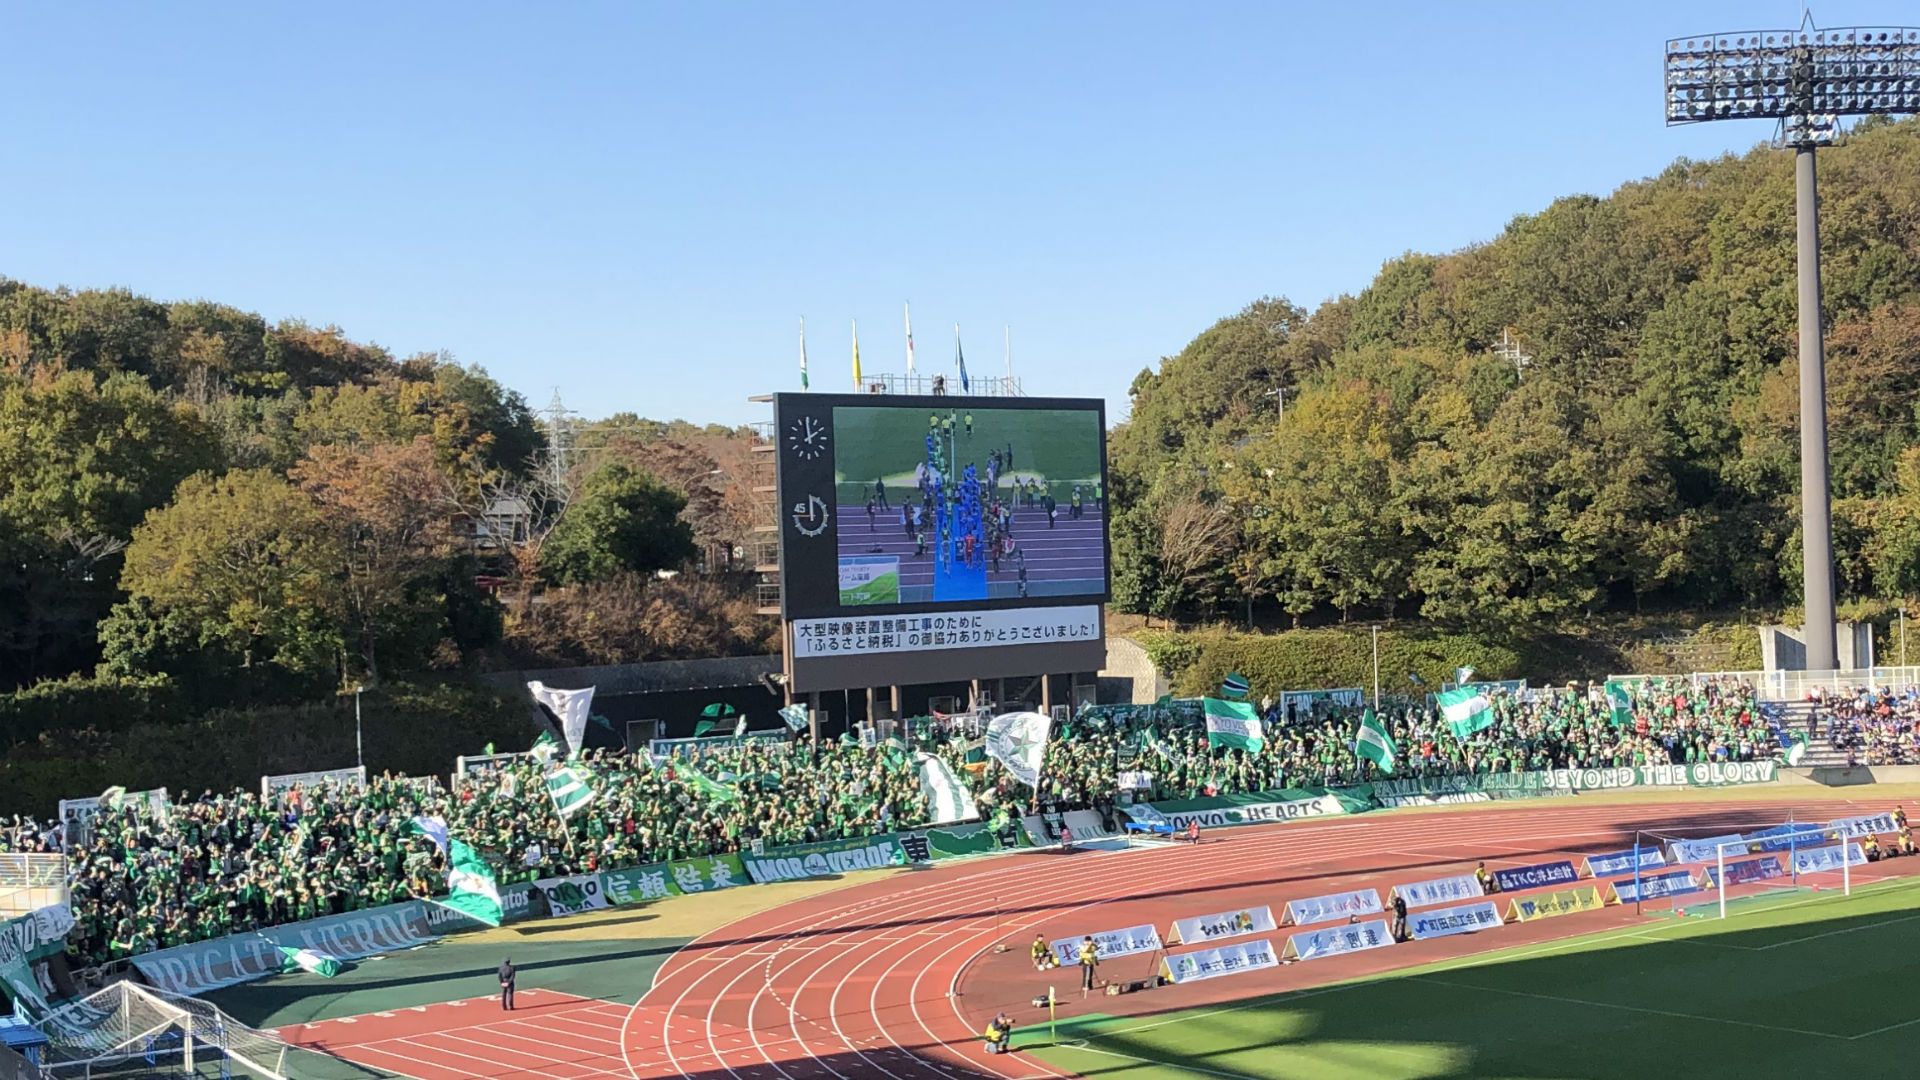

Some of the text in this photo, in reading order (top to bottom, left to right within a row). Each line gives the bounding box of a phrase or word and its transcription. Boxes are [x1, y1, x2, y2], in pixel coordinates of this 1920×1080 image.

[794, 503, 806, 513] 45
[801, 616, 982, 637] 大型映像装置整備工事のために
[1541, 760, 1775, 789] BEYOND THE GLORY
[1246, 800, 1322, 821] HEARTS
[746, 857, 804, 883] AMOR
[826, 842, 893, 872] VERDE
[607, 871, 673, 904] 信頼
[1200, 920, 1236, 936] ひまわり
[1428, 909, 1494, 931] 町田商工会議所
[1200, 957, 1246, 973] 株式会社
